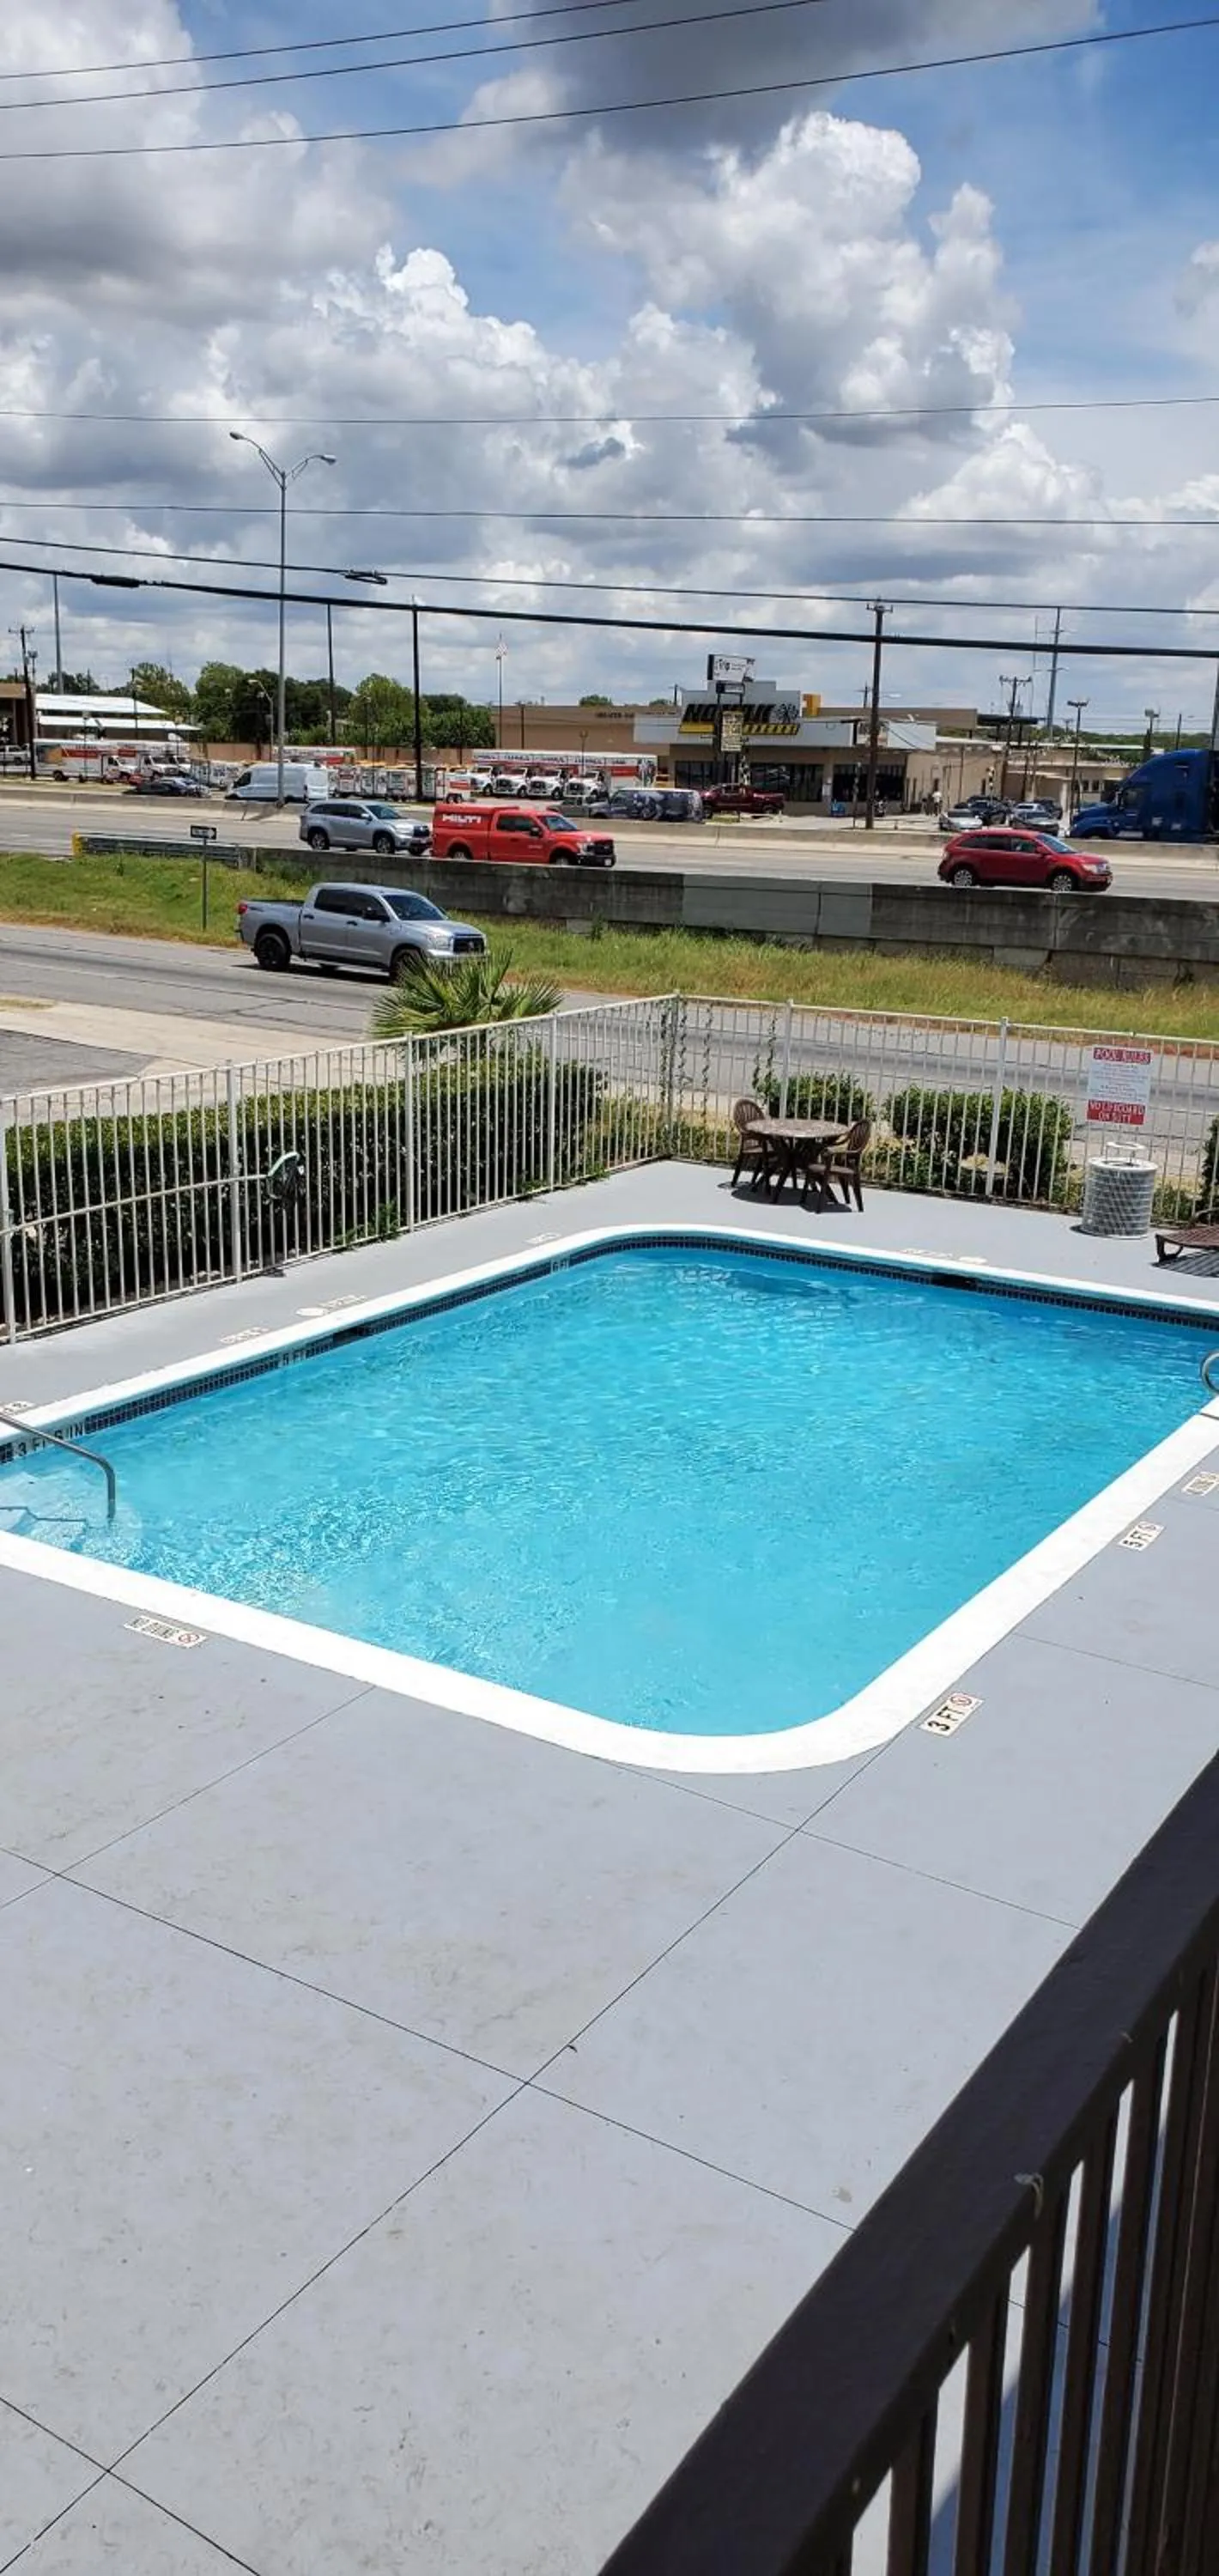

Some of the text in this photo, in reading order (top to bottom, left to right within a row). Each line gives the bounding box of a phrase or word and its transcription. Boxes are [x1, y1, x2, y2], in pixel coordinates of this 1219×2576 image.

[18, 1442, 27, 1457] 3
[927, 1705, 966, 1732] 3 FT
